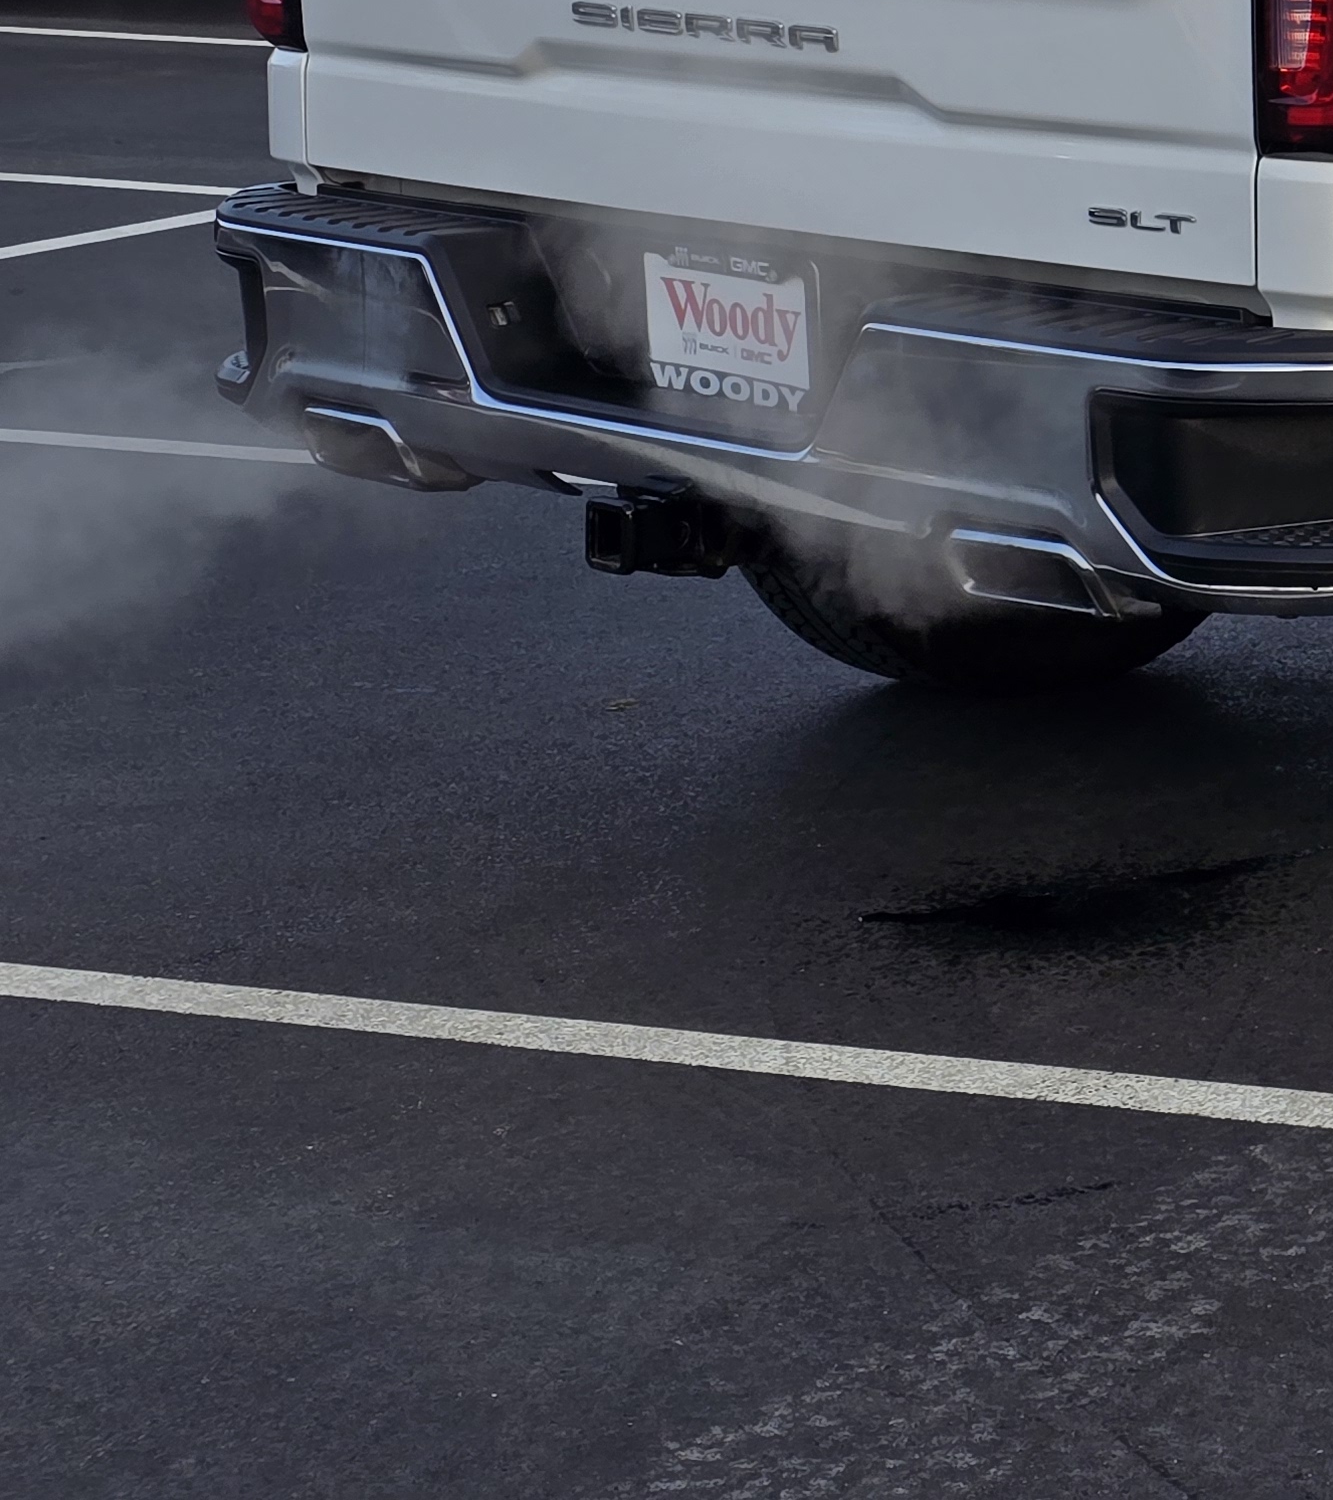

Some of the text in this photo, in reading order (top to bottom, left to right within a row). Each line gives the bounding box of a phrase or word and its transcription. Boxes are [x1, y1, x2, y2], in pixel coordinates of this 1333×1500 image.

[571, 0, 839, 53] SIERRA
[1088, 205, 1197, 235] SLT
[730, 257, 769, 277] GMC
[660, 276, 802, 363] Woody
[650, 362, 806, 412] WOODY
